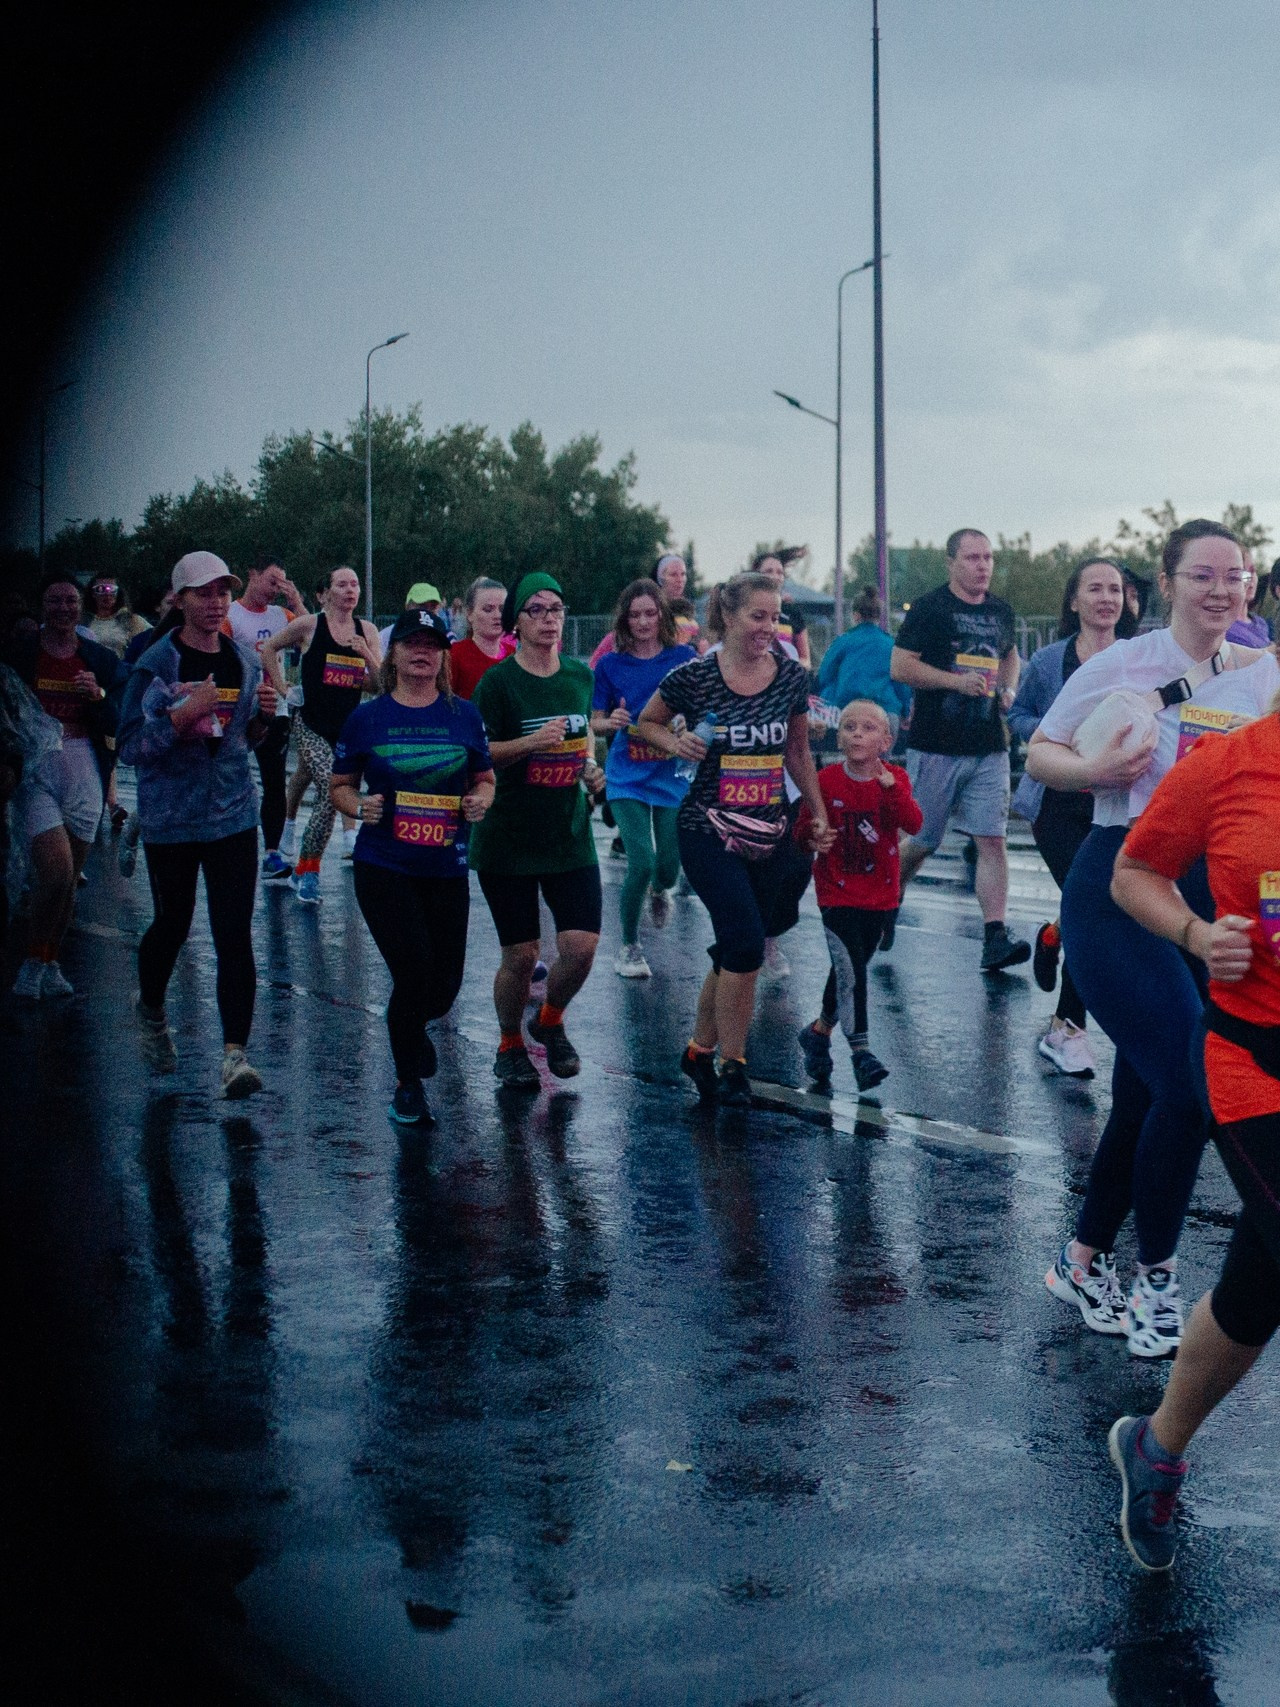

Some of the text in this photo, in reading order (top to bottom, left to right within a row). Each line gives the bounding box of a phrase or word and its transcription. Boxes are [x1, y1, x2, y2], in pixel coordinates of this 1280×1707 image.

[531, 766, 574, 784] 3272
[724, 783, 768, 803] 2631
[398, 820, 445, 843] 2390
